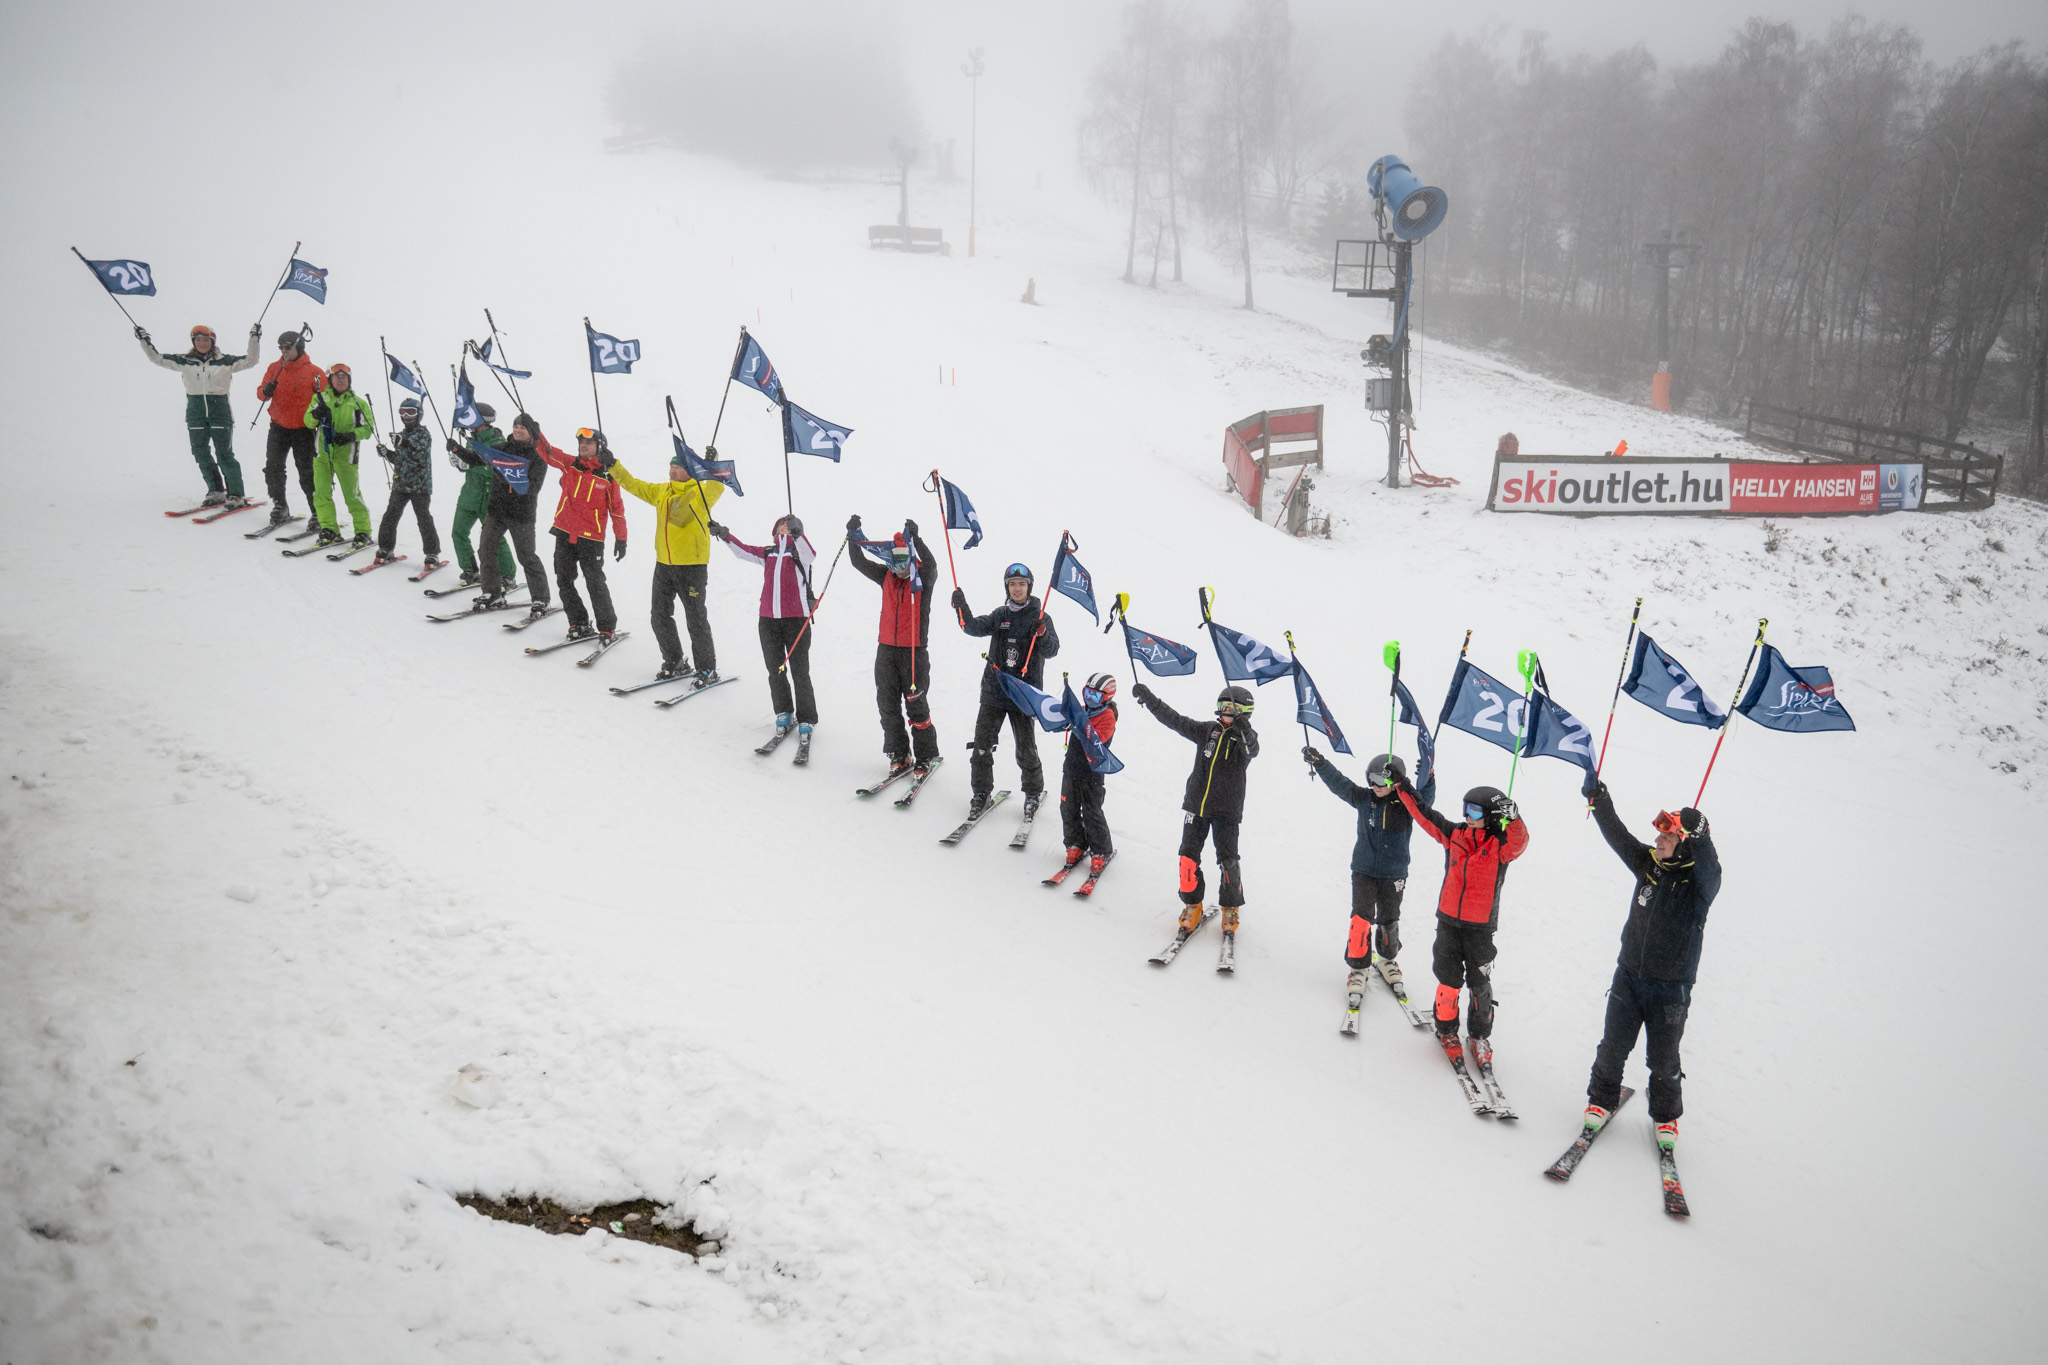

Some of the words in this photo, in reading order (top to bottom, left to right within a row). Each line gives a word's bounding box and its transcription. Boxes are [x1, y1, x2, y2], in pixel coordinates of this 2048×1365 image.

[109, 262, 149, 290] 20
[594, 338, 637, 367] 20
[1502, 470, 1723, 504] skioutlet.hu
[1732, 479, 1790, 497] HELLY
[1793, 479, 1855, 497] HANSEN
[1472, 690, 1531, 738] 20
